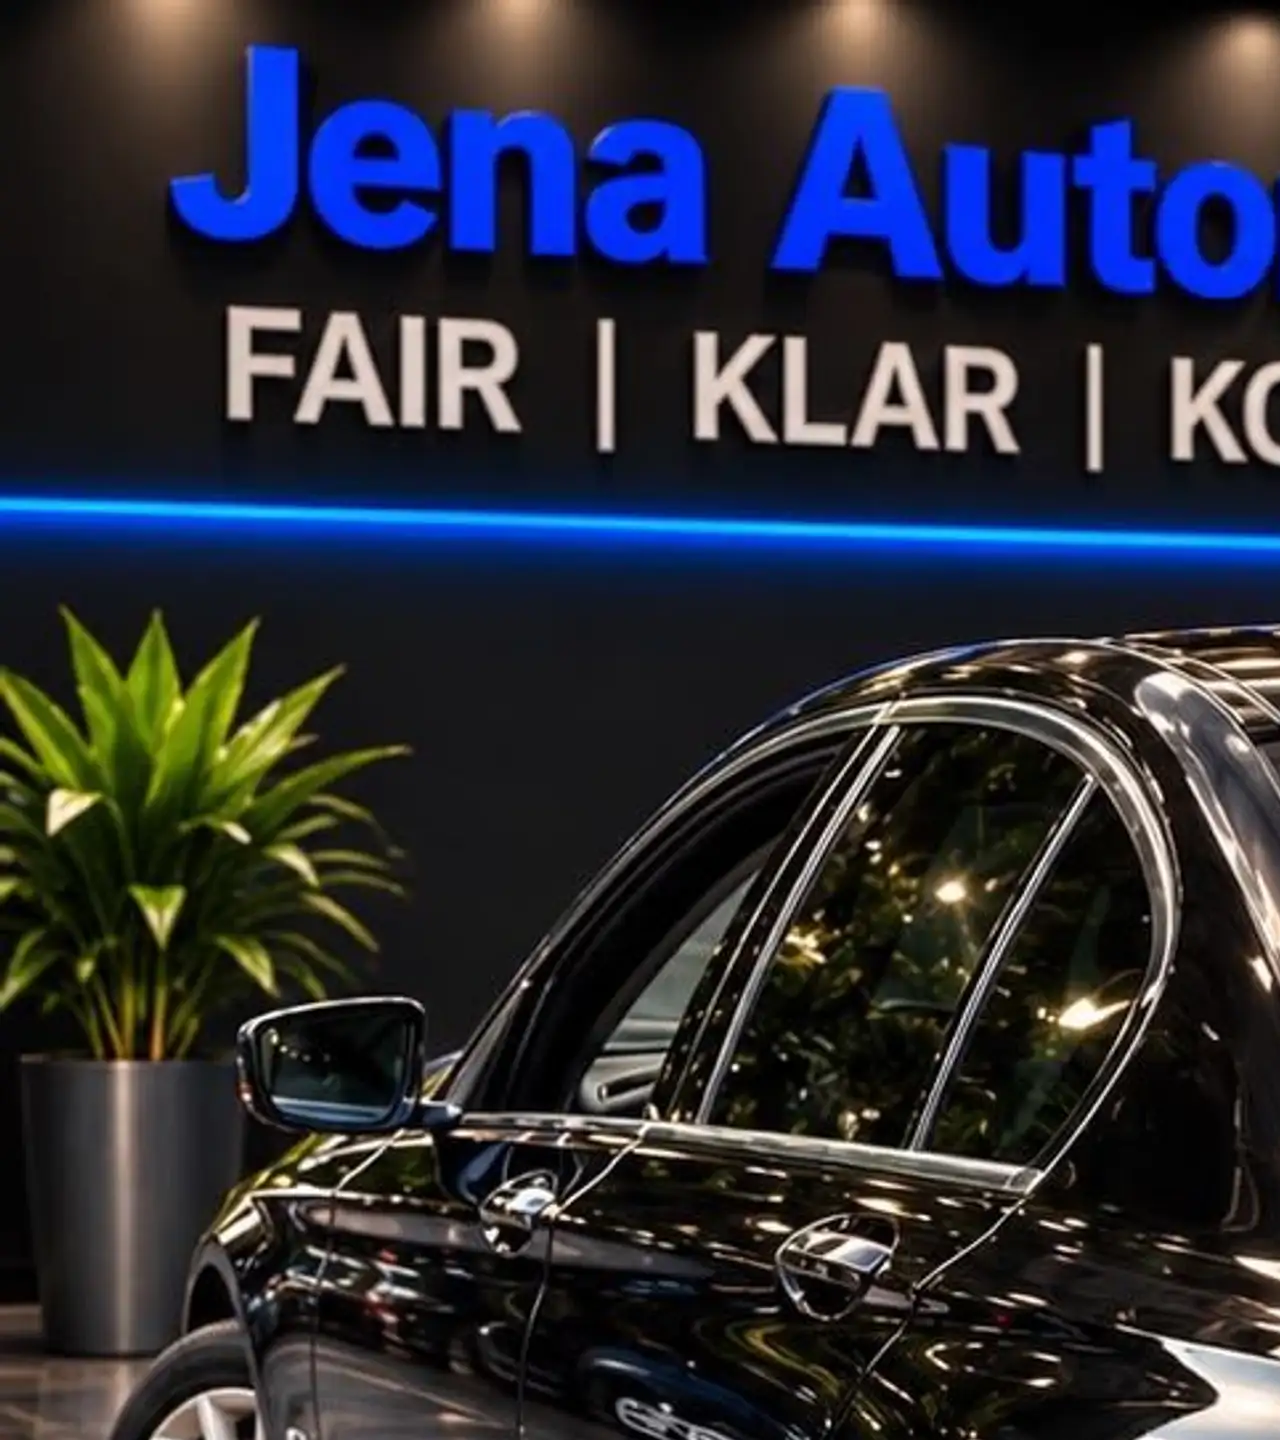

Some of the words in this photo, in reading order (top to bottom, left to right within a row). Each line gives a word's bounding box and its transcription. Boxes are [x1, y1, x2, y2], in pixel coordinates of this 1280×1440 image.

[170, 44, 709, 266] Jena
[225, 305, 522, 433] FAIR
[692, 331, 1021, 454] KLAR
